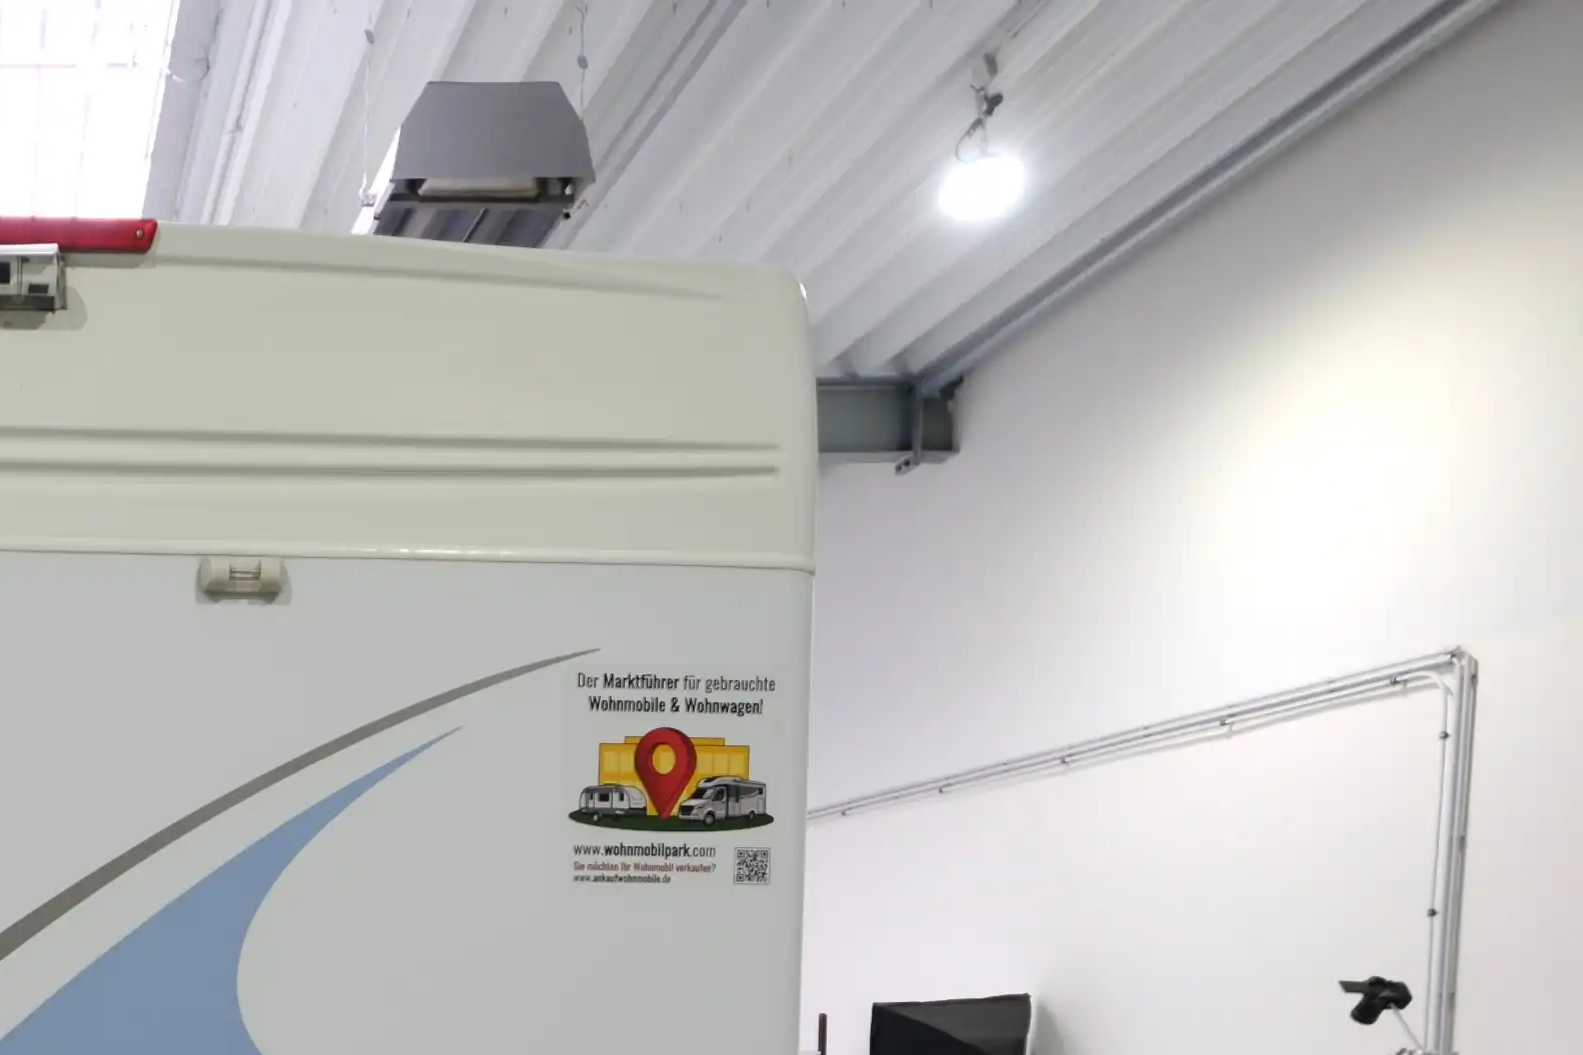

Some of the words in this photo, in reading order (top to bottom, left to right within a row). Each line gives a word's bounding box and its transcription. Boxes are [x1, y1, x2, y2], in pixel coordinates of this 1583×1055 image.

[577, 672, 599, 688] Der
[602, 673, 679, 690] Marktführer
[683, 675, 701, 690] für
[705, 676, 776, 693] gebrauchte
[589, 695, 666, 713] Wohnmobile
[670, 697, 680, 713] &
[685, 698, 763, 717] Wohnwagen!
[573, 843, 716, 859] www.wohnmobilpark.com
[573, 861, 585, 871] Sie
